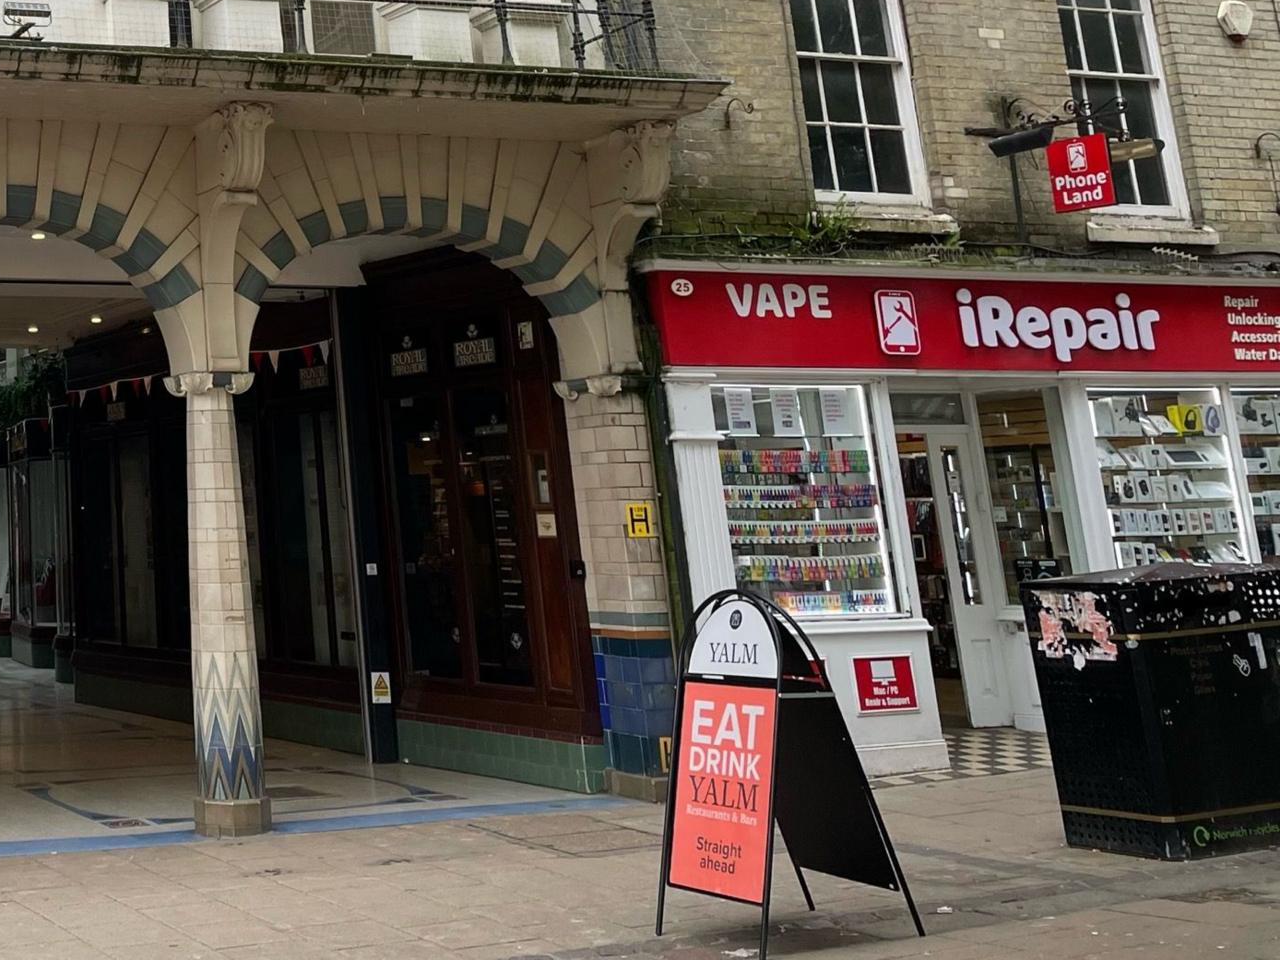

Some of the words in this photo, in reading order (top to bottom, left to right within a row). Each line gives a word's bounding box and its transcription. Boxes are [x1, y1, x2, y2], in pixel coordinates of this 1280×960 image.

[1055, 172, 1107, 191] Phone
[1063, 185, 1103, 205] Land
[675, 282, 690, 292] 25
[725, 283, 832, 318] VAPE
[1223, 295, 1259, 311] Repair
[956, 288, 1160, 362] iRepair
[1227, 312, 1280, 328] Unlocking
[455, 338, 494, 356] ROYAL
[1234, 348, 1267, 360] Water
[391, 349, 427, 366] ROYAL
[629, 506, 650, 535] H
[709, 642, 759, 665] YALM
[873, 686, 886, 695] Mac
[890, 685, 899, 695] PC
[690, 699, 765, 750] EAT
[688, 745, 761, 781] DRINK
[688, 774, 759, 813] YALM
[686, 803, 730, 822] Restaurants
[740, 813, 758, 827] Bars
[696, 836, 742, 859] Straight
[700, 855, 735, 875] ahead
